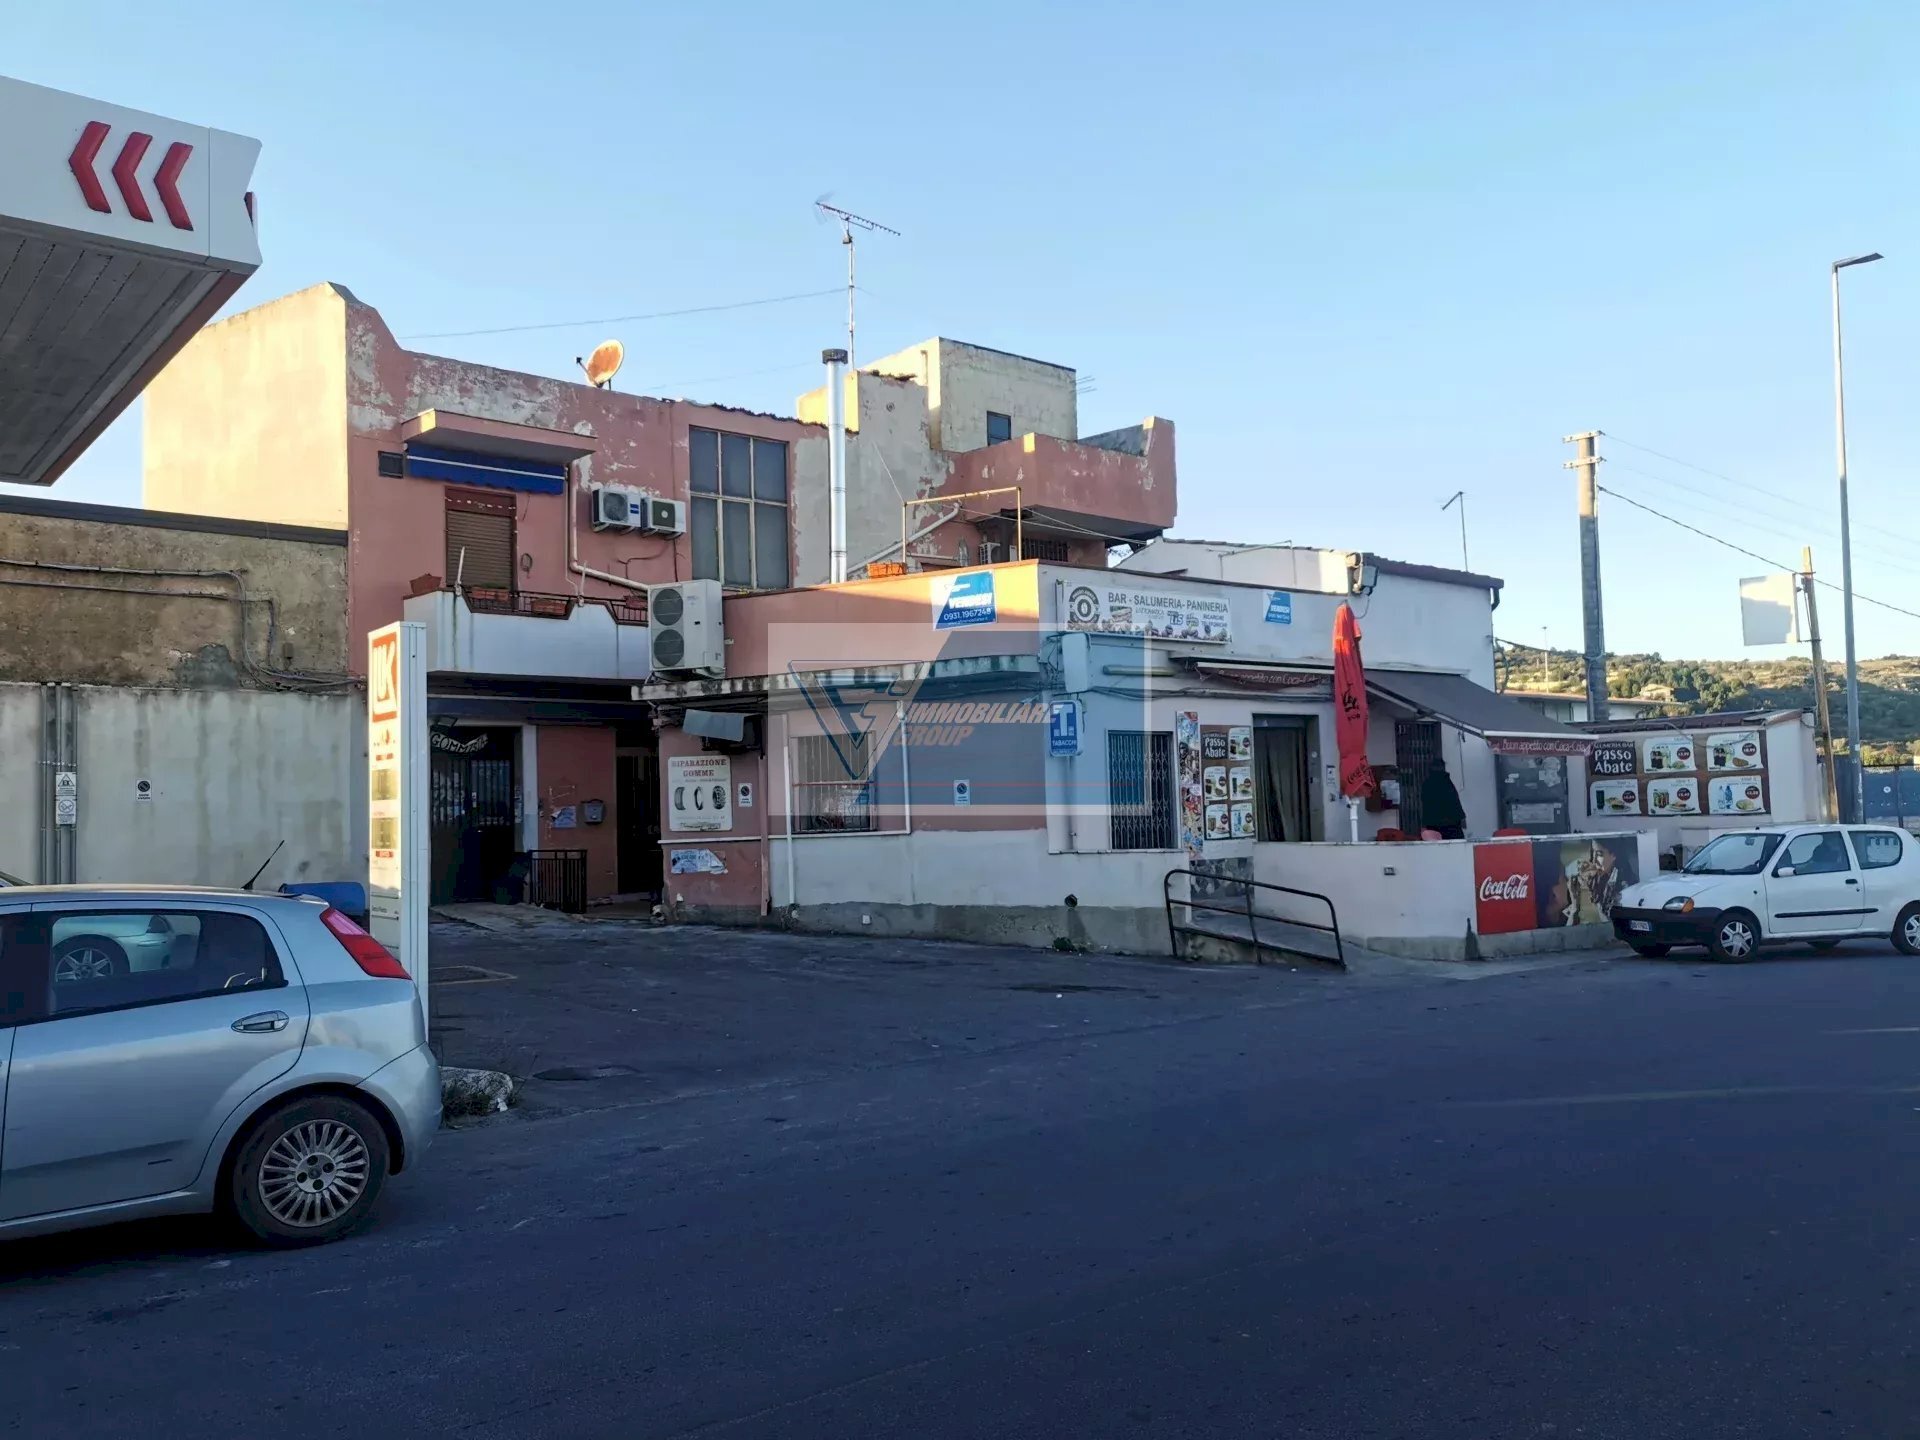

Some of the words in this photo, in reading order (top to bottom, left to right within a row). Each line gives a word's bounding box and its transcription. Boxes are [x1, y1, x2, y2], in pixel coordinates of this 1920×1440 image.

[1108, 592, 1127, 604] BAR
[1186, 600, 1229, 613] PANINERIA
[1052, 739, 1077, 747] TABACCHI
[1205, 737, 1226, 747] Passo
[1204, 746, 1226, 758] Abate
[1594, 749, 1632, 762] Passo
[671, 758, 727, 767] RIPARAZIONE
[1594, 761, 1633, 774] Abate
[683, 769, 715, 777] GOMME
[1480, 874, 1530, 902] Coca-Cola
